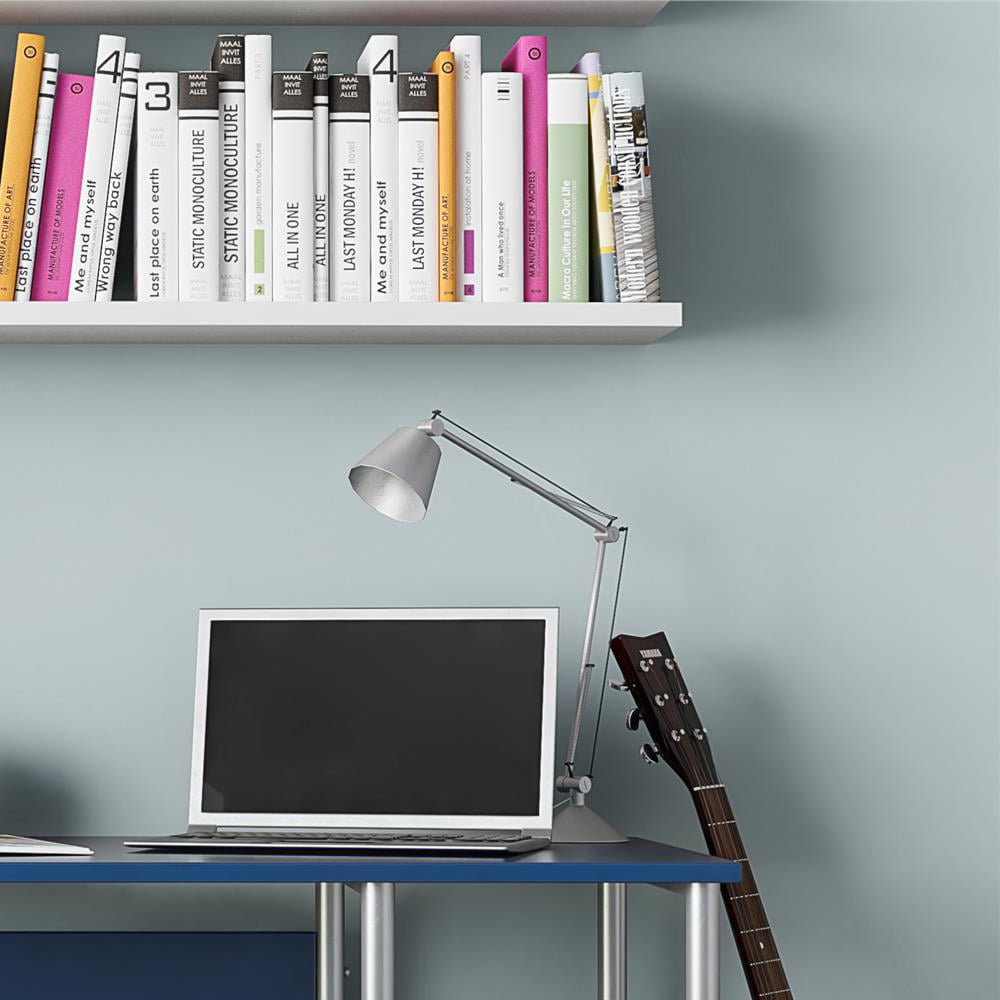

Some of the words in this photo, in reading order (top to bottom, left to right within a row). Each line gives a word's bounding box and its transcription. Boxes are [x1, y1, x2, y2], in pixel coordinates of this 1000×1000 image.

[97, 50, 121, 84] 4
[373, 50, 397, 82] 4
[145, 82, 170, 111] 3
[224, 104, 238, 212] MONOCULTURE
[464, 152, 472, 174] home
[29, 157, 42, 193] earth
[149, 168, 159, 202] earth
[192, 130, 204, 225] MONOCULTURE
[344, 168, 356, 181] H!
[412, 167, 424, 180] H!
[562, 180, 571, 196] Life
[84, 180, 96, 228] myself
[108, 172, 121, 208] back
[4, 203, 12, 213] OF
[27, 198, 37, 216] on
[152, 208, 159, 224] on
[287, 202, 299, 228] ONE
[315, 194, 326, 222] ONE
[344, 184, 356, 238] MONDAY
[377, 181, 388, 229] myself
[412, 183, 424, 238] MONDAY
[442, 212, 449, 220] OF
[464, 186, 472, 226] instalation
[529, 205, 536, 216] OF
[562, 200, 571, 217] Our
[614, 190, 642, 245] wooden
[48, 227, 60, 280] MANUFACTURE
[56, 189, 65, 217] MODELS
[105, 213, 119, 242] way
[287, 231, 299, 244] IN
[315, 226, 326, 239] IN
[562, 218, 571, 228] In
[20, 221, 34, 262] place
[80, 234, 89, 263] and
[150, 228, 161, 268] place
[192, 228, 204, 269] STATIC
[224, 216, 238, 263] STATIC
[377, 235, 387, 265] and
[562, 235, 571, 265] Culture
[287, 248, 299, 270] ALL
[315, 244, 326, 266] ALL
[344, 241, 356, 271] LAST
[412, 241, 424, 270] LAST
[17, 265, 28, 292] Last
[75, 268, 86, 292] Me
[96, 248, 115, 292] Wrong
[377, 270, 387, 294] Me
[562, 268, 571, 300] Macro
[150, 272, 160, 298] Last
